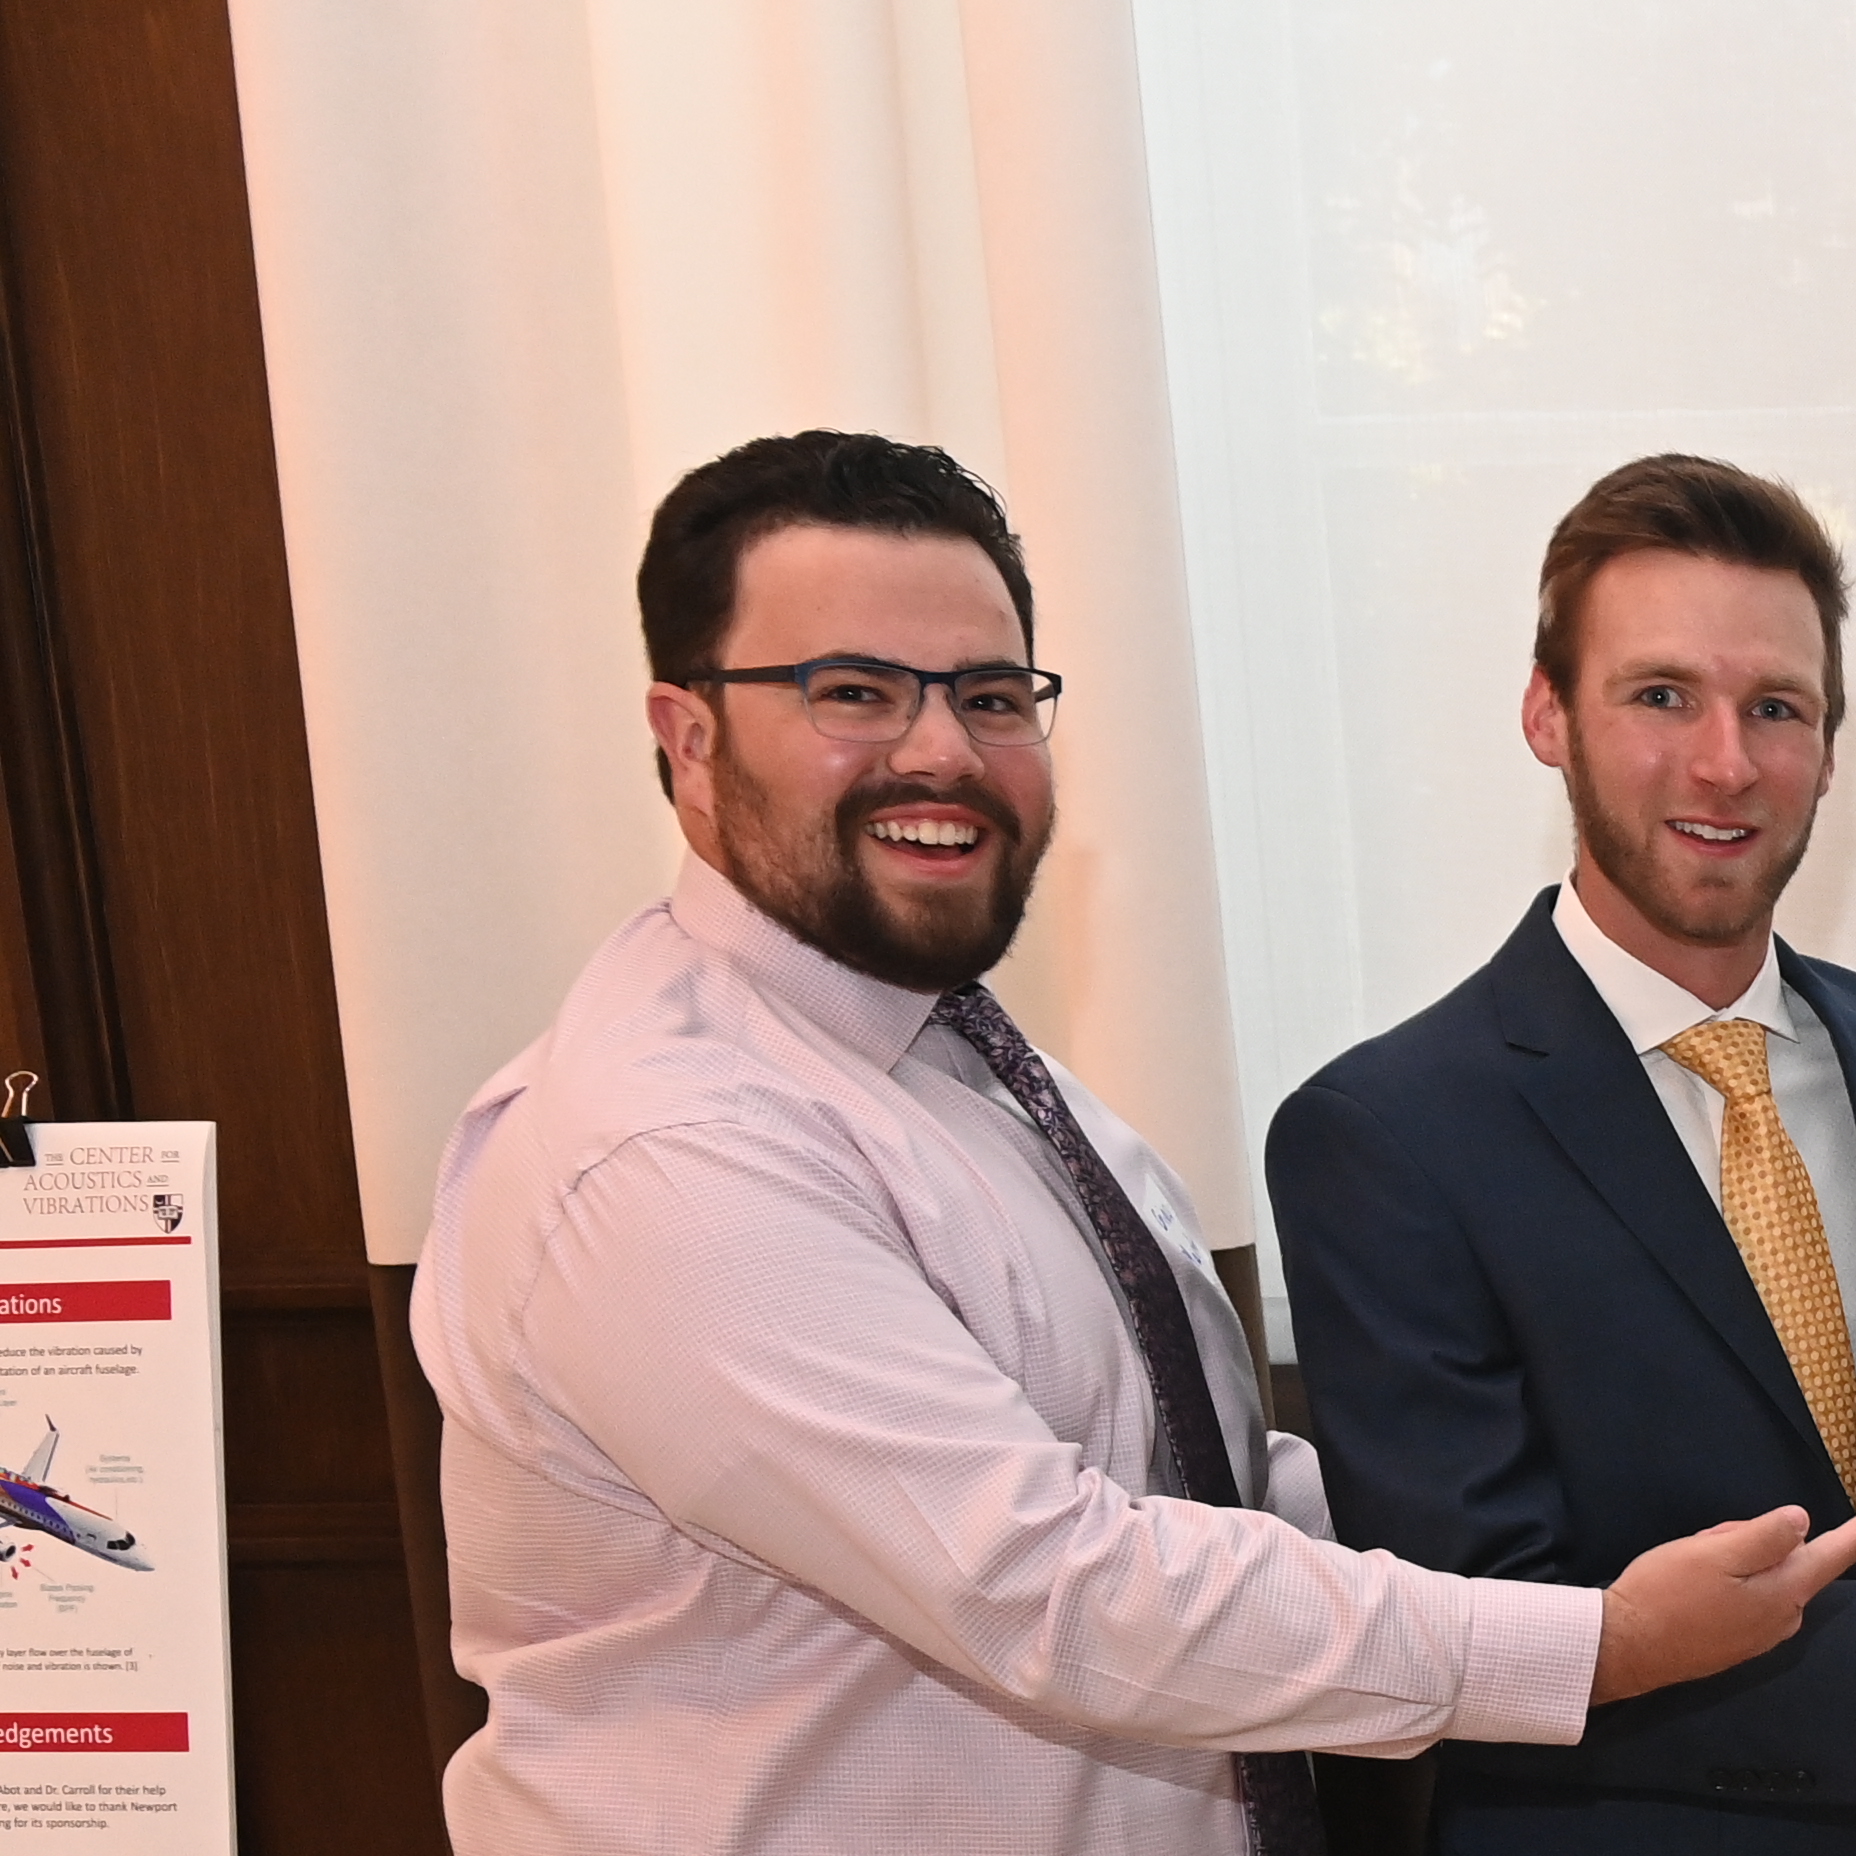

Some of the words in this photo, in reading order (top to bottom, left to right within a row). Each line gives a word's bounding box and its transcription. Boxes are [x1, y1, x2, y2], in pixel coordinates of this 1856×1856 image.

[70, 1147, 154, 1165] CENTER
[23, 1171, 143, 1191] ACOUSTICS
[23, 1194, 150, 1215] VIBRATIONS
[14, 1817, 28, 1828] for
[31, 1818, 44, 1829] its
[46, 1818, 109, 1830] sponsorship.
